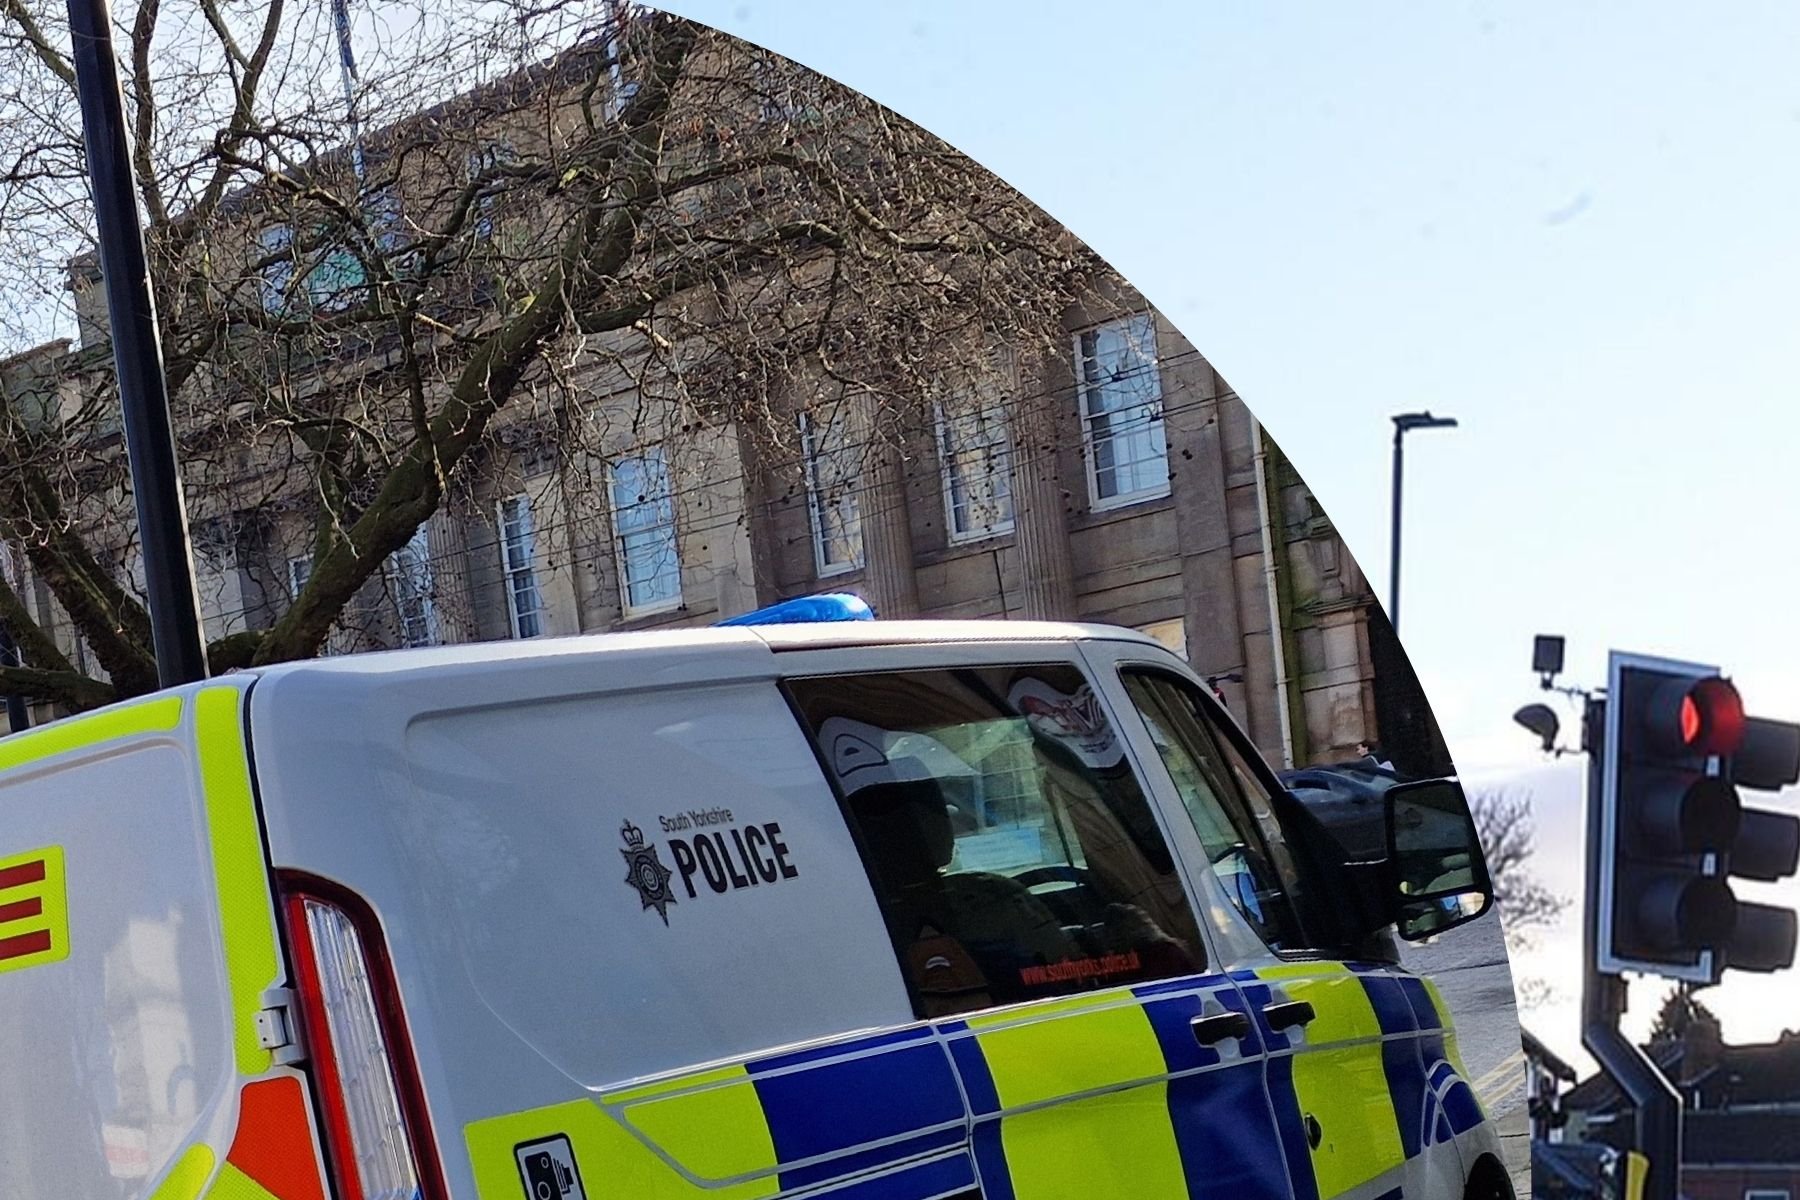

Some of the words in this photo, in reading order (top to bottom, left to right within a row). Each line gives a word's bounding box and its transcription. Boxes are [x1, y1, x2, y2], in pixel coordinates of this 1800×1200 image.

[659, 814, 692, 833] South
[688, 805, 734, 828] Yorkshire
[668, 822, 798, 898] POLICE
